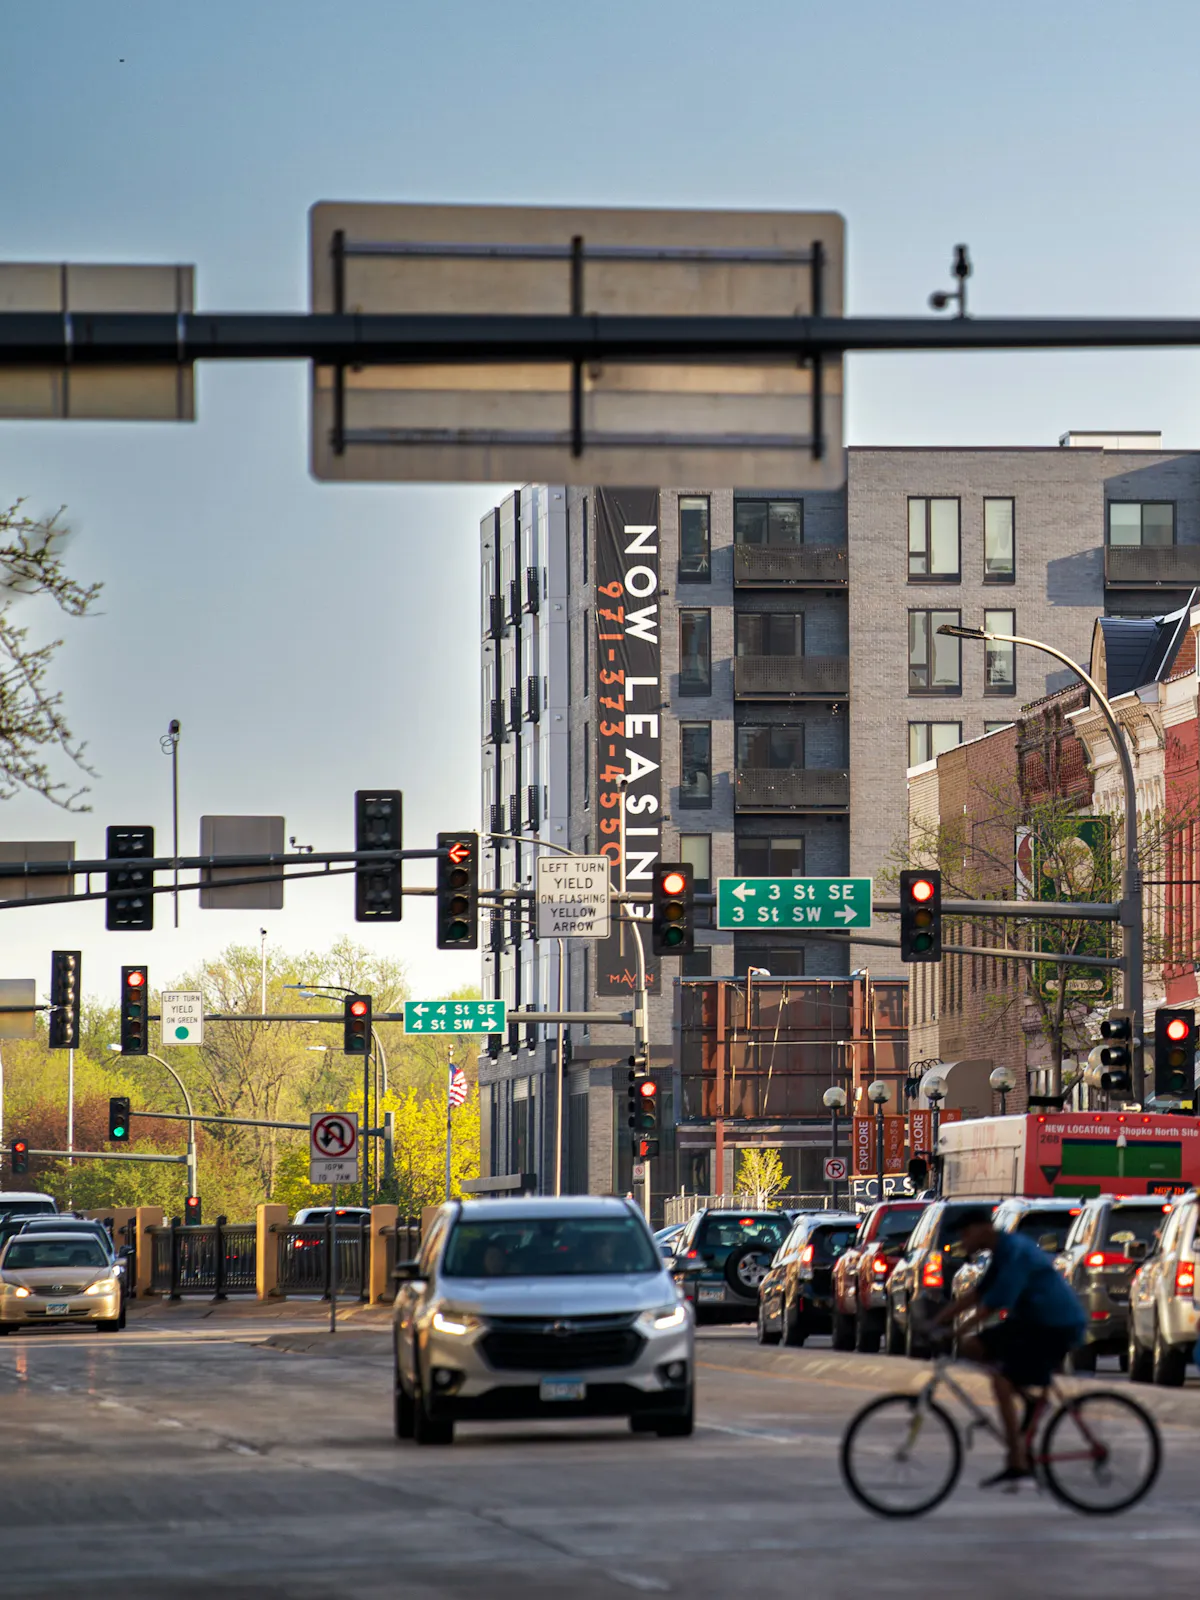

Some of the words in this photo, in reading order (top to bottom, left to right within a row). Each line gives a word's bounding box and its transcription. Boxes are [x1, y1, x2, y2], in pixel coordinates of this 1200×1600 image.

[624, 525, 658, 644] NOW
[541, 863, 568, 873] LEFT
[575, 863, 604, 872] TURN
[554, 877, 593, 889] YIELD
[768, 884, 781, 900] 3
[793, 884, 815, 900] St
[828, 884, 854, 900] SE
[541, 895, 553, 904] ON
[559, 894, 605, 903] FLASHING
[551, 907, 596, 918] YELLOW
[732, 907, 745, 922] 3
[757, 907, 780, 922] St
[792, 906, 822, 922] SW
[553, 921, 593, 931] ARROW
[609, 969, 653, 988] MAVN
[171, 1005, 193, 1013] YIELD
[436, 1004, 447, 1015] 4
[454, 1004, 470, 1015] St
[477, 1004, 495, 1015] SE
[412, 1019, 423, 1030] 4
[430, 1019, 446, 1030] St
[453, 1019, 474, 1030] SW
[1045, 1124, 1065, 1133] NEW
[1067, 1125, 1110, 1135] LOCATION
[1119, 1126, 1152, 1137] Shopko
[1155, 1127, 1179, 1136] North
[1181, 1128, 1199, 1137] Site
[1040, 1135, 1059, 1144] 268
[859, 1121, 868, 1171] EXPLORE
